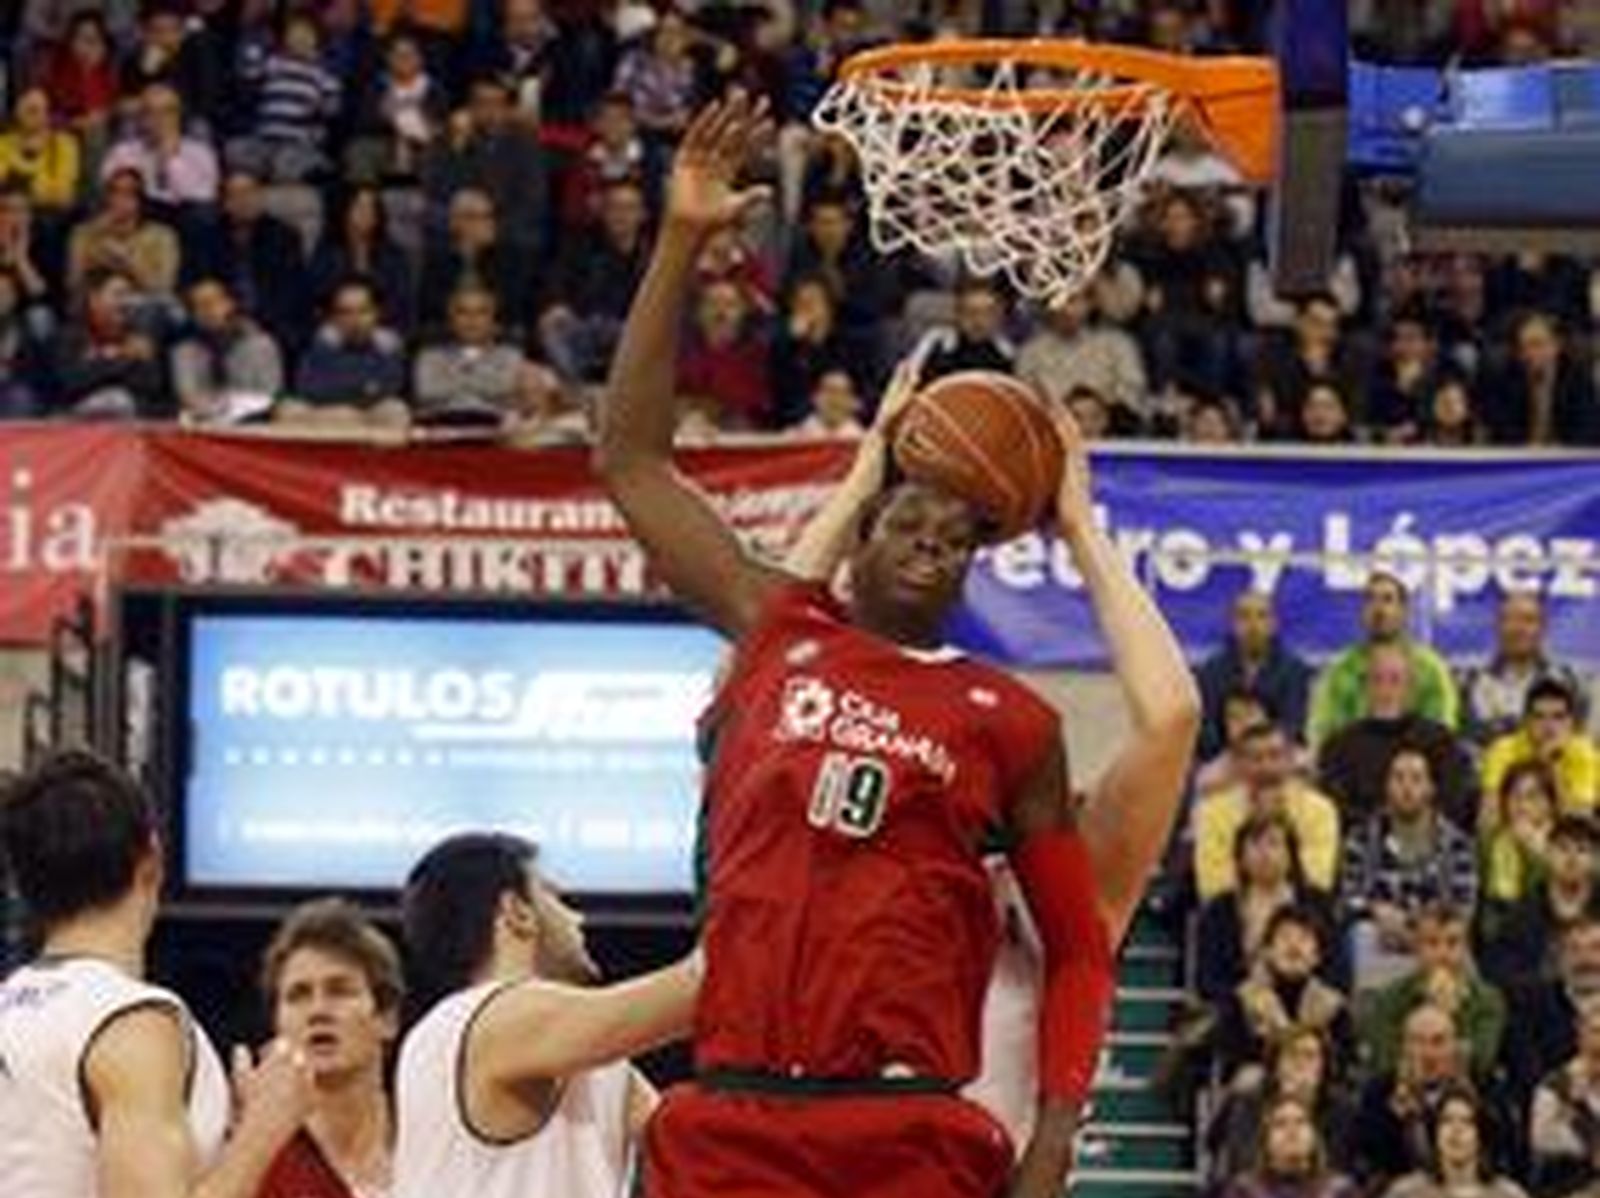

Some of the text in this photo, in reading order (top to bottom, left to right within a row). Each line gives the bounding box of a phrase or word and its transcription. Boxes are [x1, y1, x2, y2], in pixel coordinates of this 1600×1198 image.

[340, 482, 630, 530] Restauran
[1324, 511, 1596, 612] López
[220, 665, 516, 721] ROTULOS
